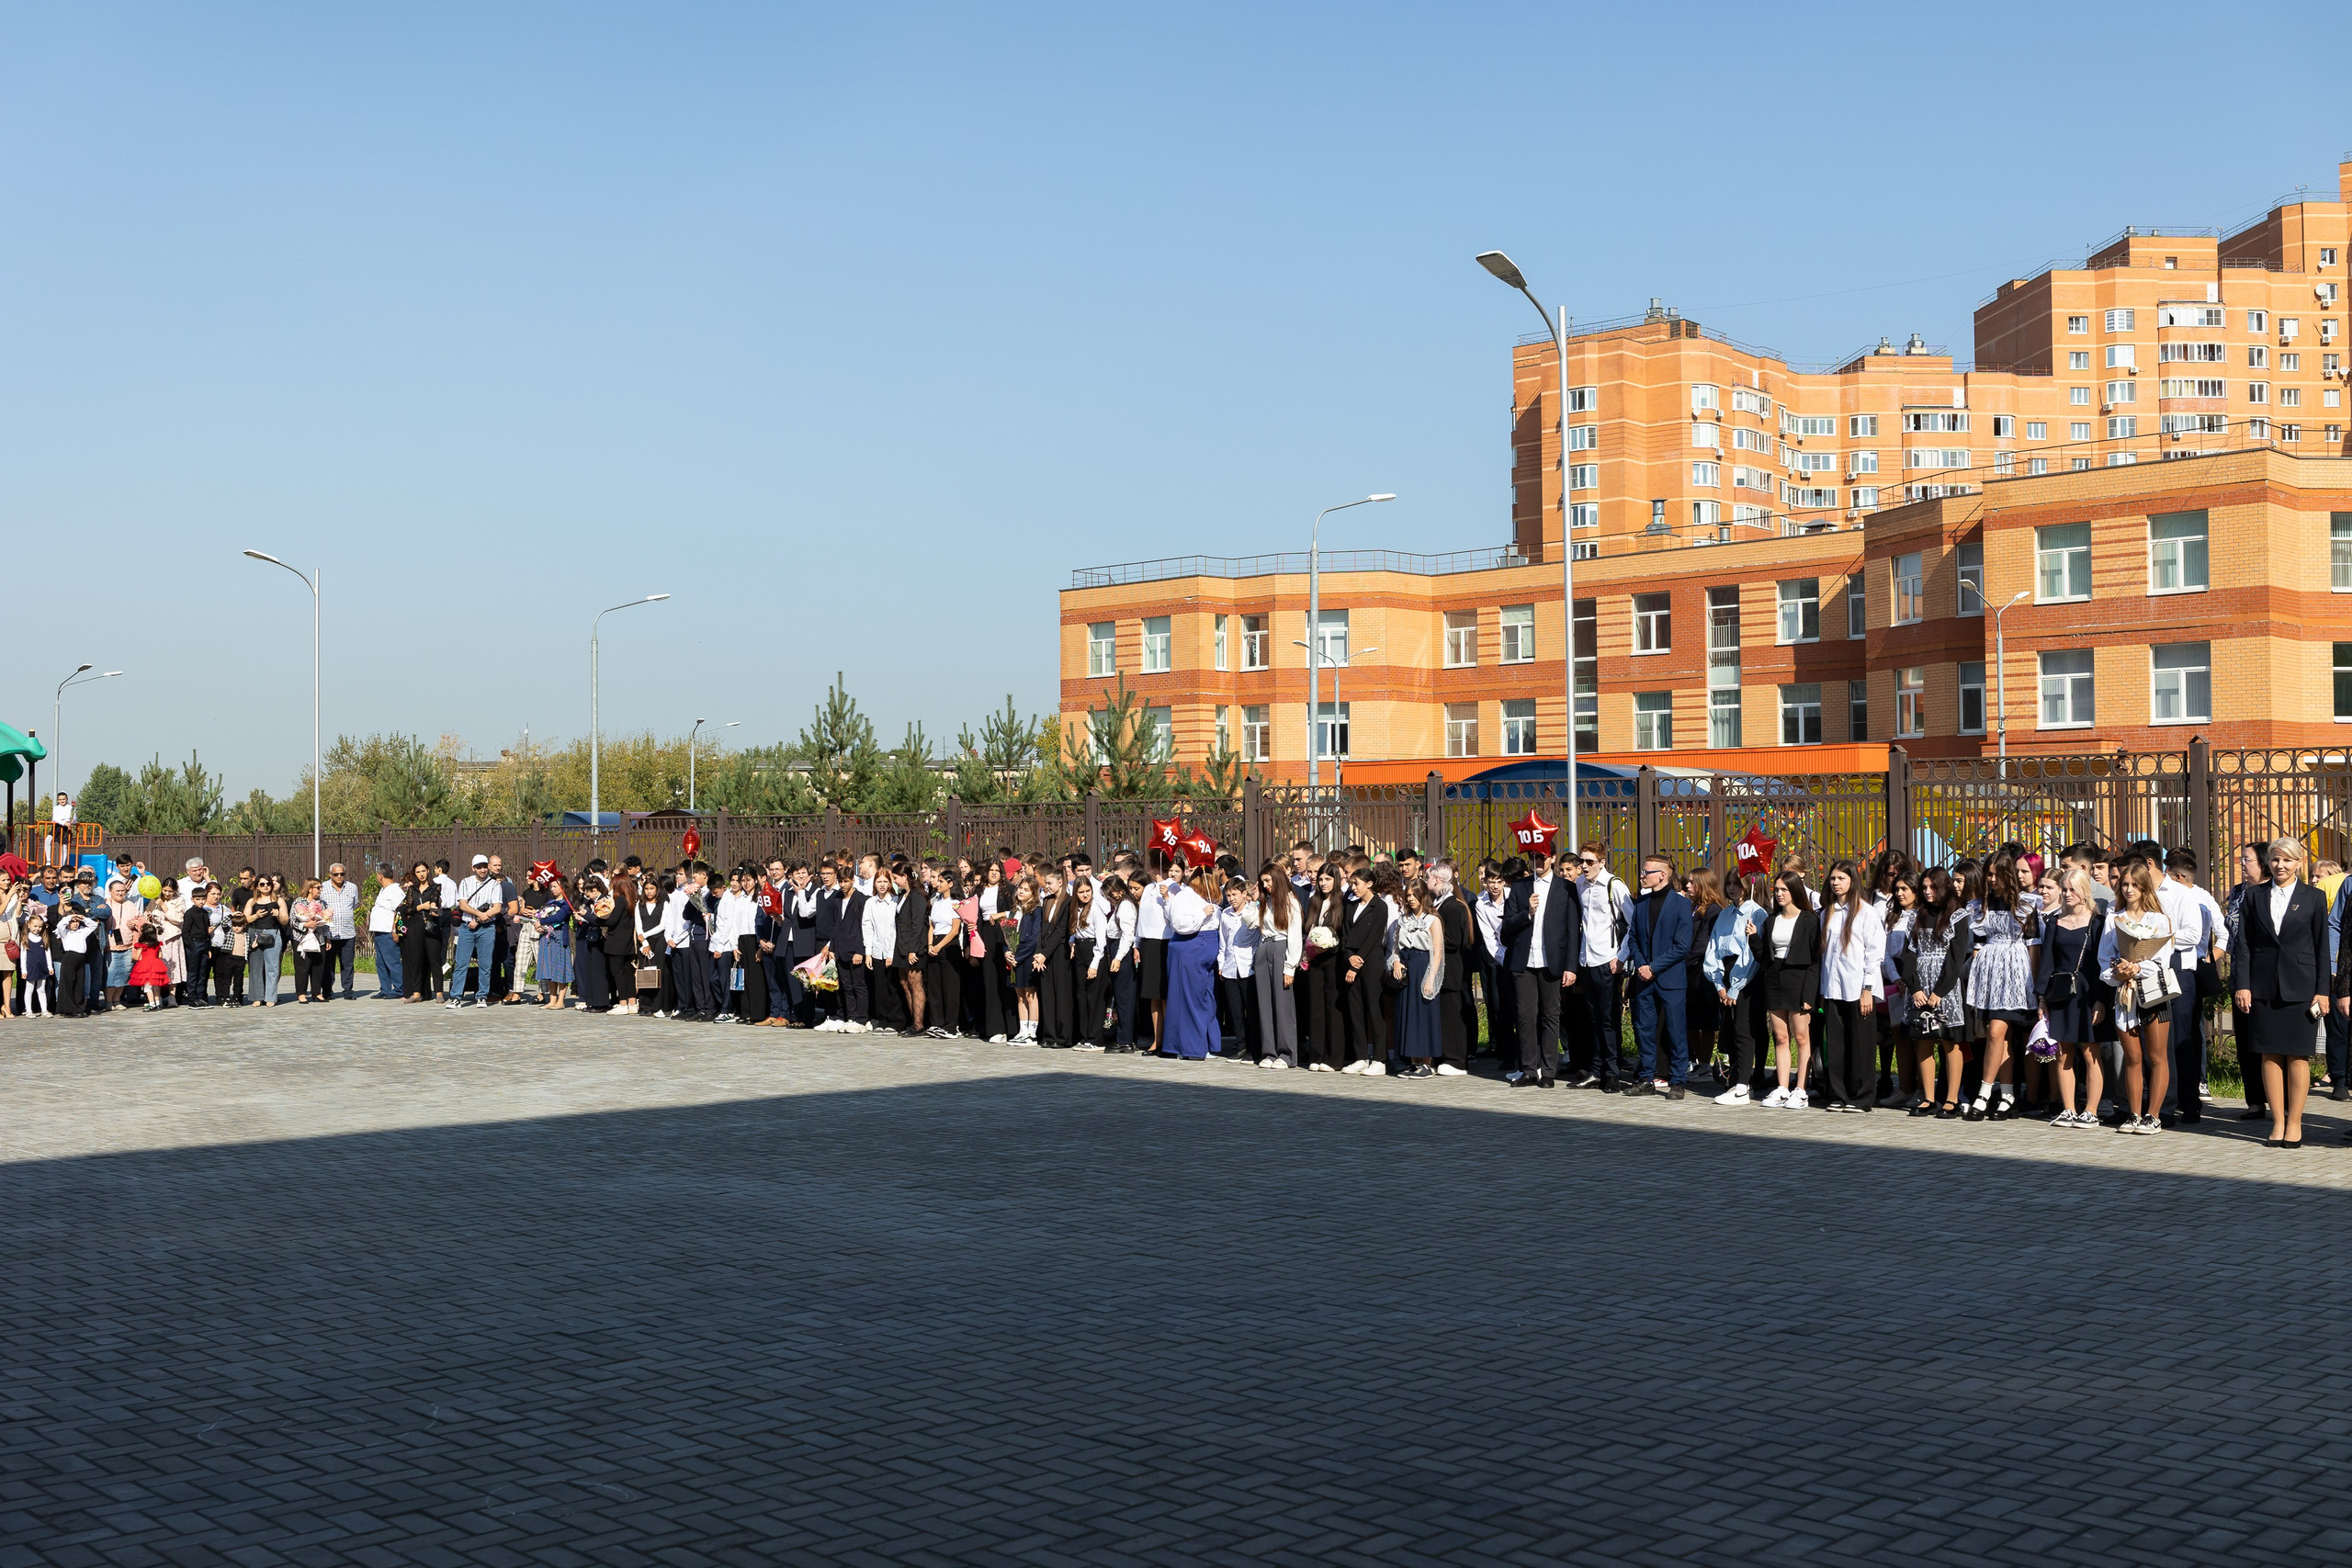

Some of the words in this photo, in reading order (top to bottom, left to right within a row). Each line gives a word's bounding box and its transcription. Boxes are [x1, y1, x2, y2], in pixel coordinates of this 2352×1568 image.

[1162, 828, 1178, 846] 9Б
[1198, 840, 1212, 854] 9А
[1736, 842, 1758, 861] 10А
[536, 868, 555, 884] 9Д
[757, 895, 772, 908] 9В
